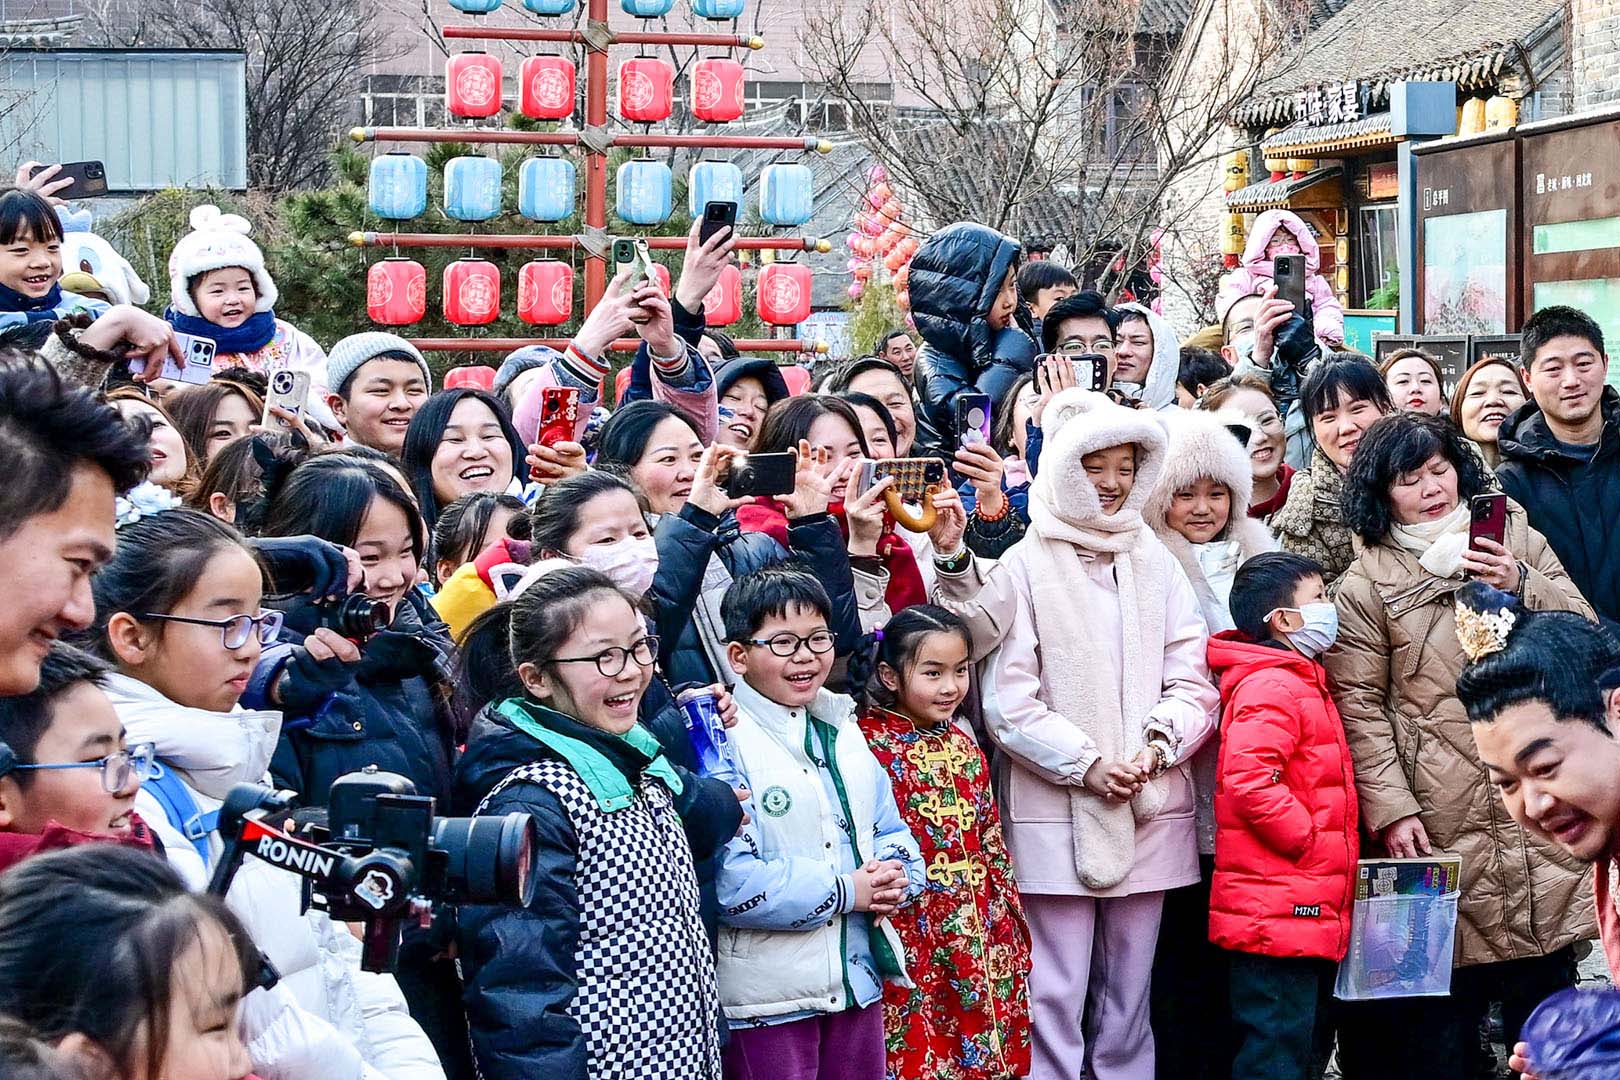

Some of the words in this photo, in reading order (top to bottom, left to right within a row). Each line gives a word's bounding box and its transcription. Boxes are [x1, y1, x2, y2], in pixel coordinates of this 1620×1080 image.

[257, 834, 334, 877] RONIN
[727, 891, 768, 917] SNOOPY
[1294, 905, 1320, 916] MINI
